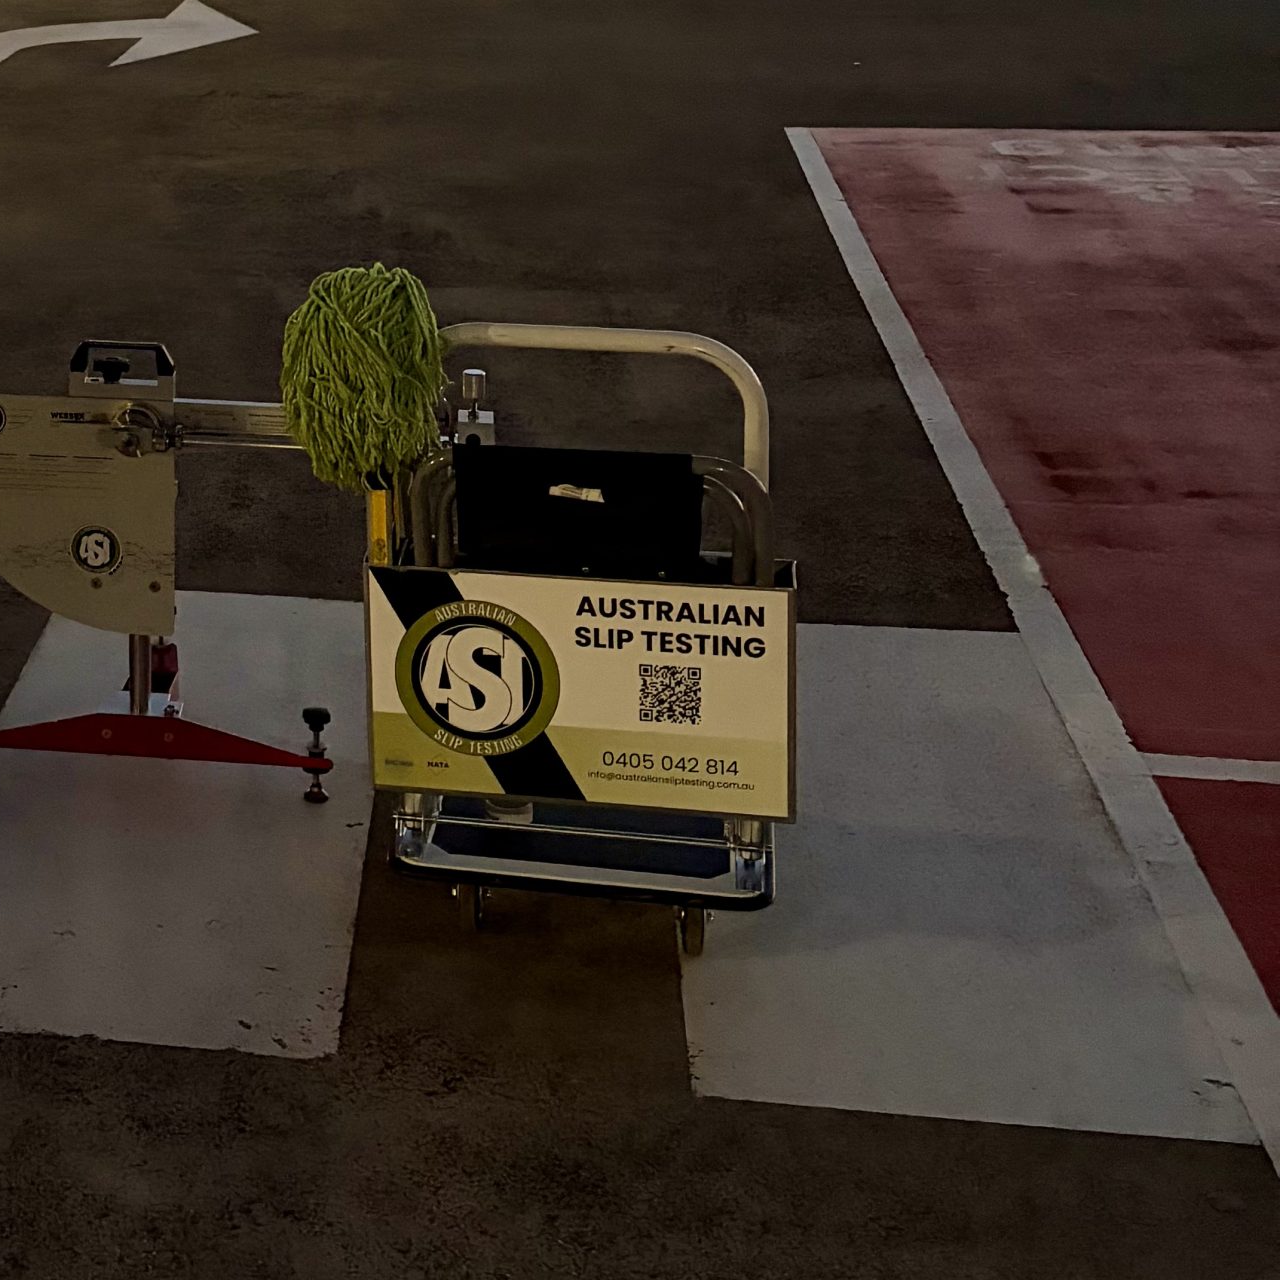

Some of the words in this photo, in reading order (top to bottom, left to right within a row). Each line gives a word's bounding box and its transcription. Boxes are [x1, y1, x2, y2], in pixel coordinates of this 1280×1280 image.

[434, 602, 516, 626] AUSTRALIAN
[576, 596, 765, 627] AUSTRALIAN
[575, 626, 634, 649] SLIP
[641, 631, 766, 658] TESTING
[434, 728, 463, 749] SLIP
[470, 734, 523, 754] TESTING
[602, 751, 654, 769] 0405
[661, 755, 699, 773] 042
[706, 758, 739, 776] 814
[587, 770, 755, 791] info@australiansliptesting.com.au
